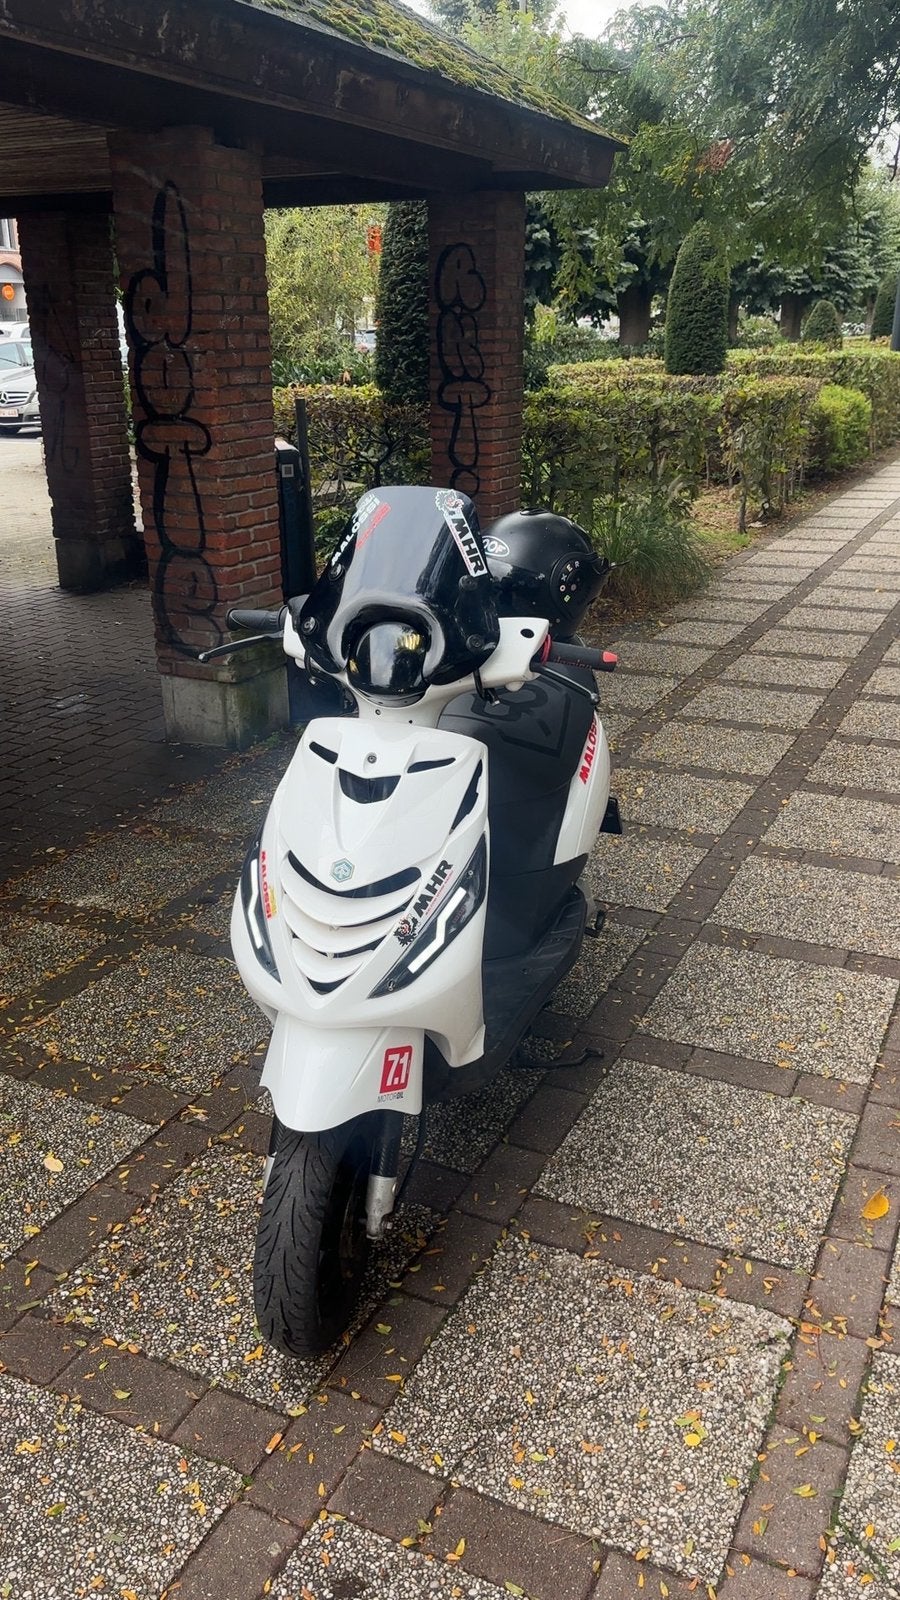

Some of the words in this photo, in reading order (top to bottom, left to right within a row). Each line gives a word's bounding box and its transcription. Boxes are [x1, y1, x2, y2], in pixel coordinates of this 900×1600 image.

[331, 496, 380, 567] MALOSSI
[451, 518, 485, 575] MHR
[261, 851, 272, 919] MALOSSI
[412, 859, 454, 918] MHR
